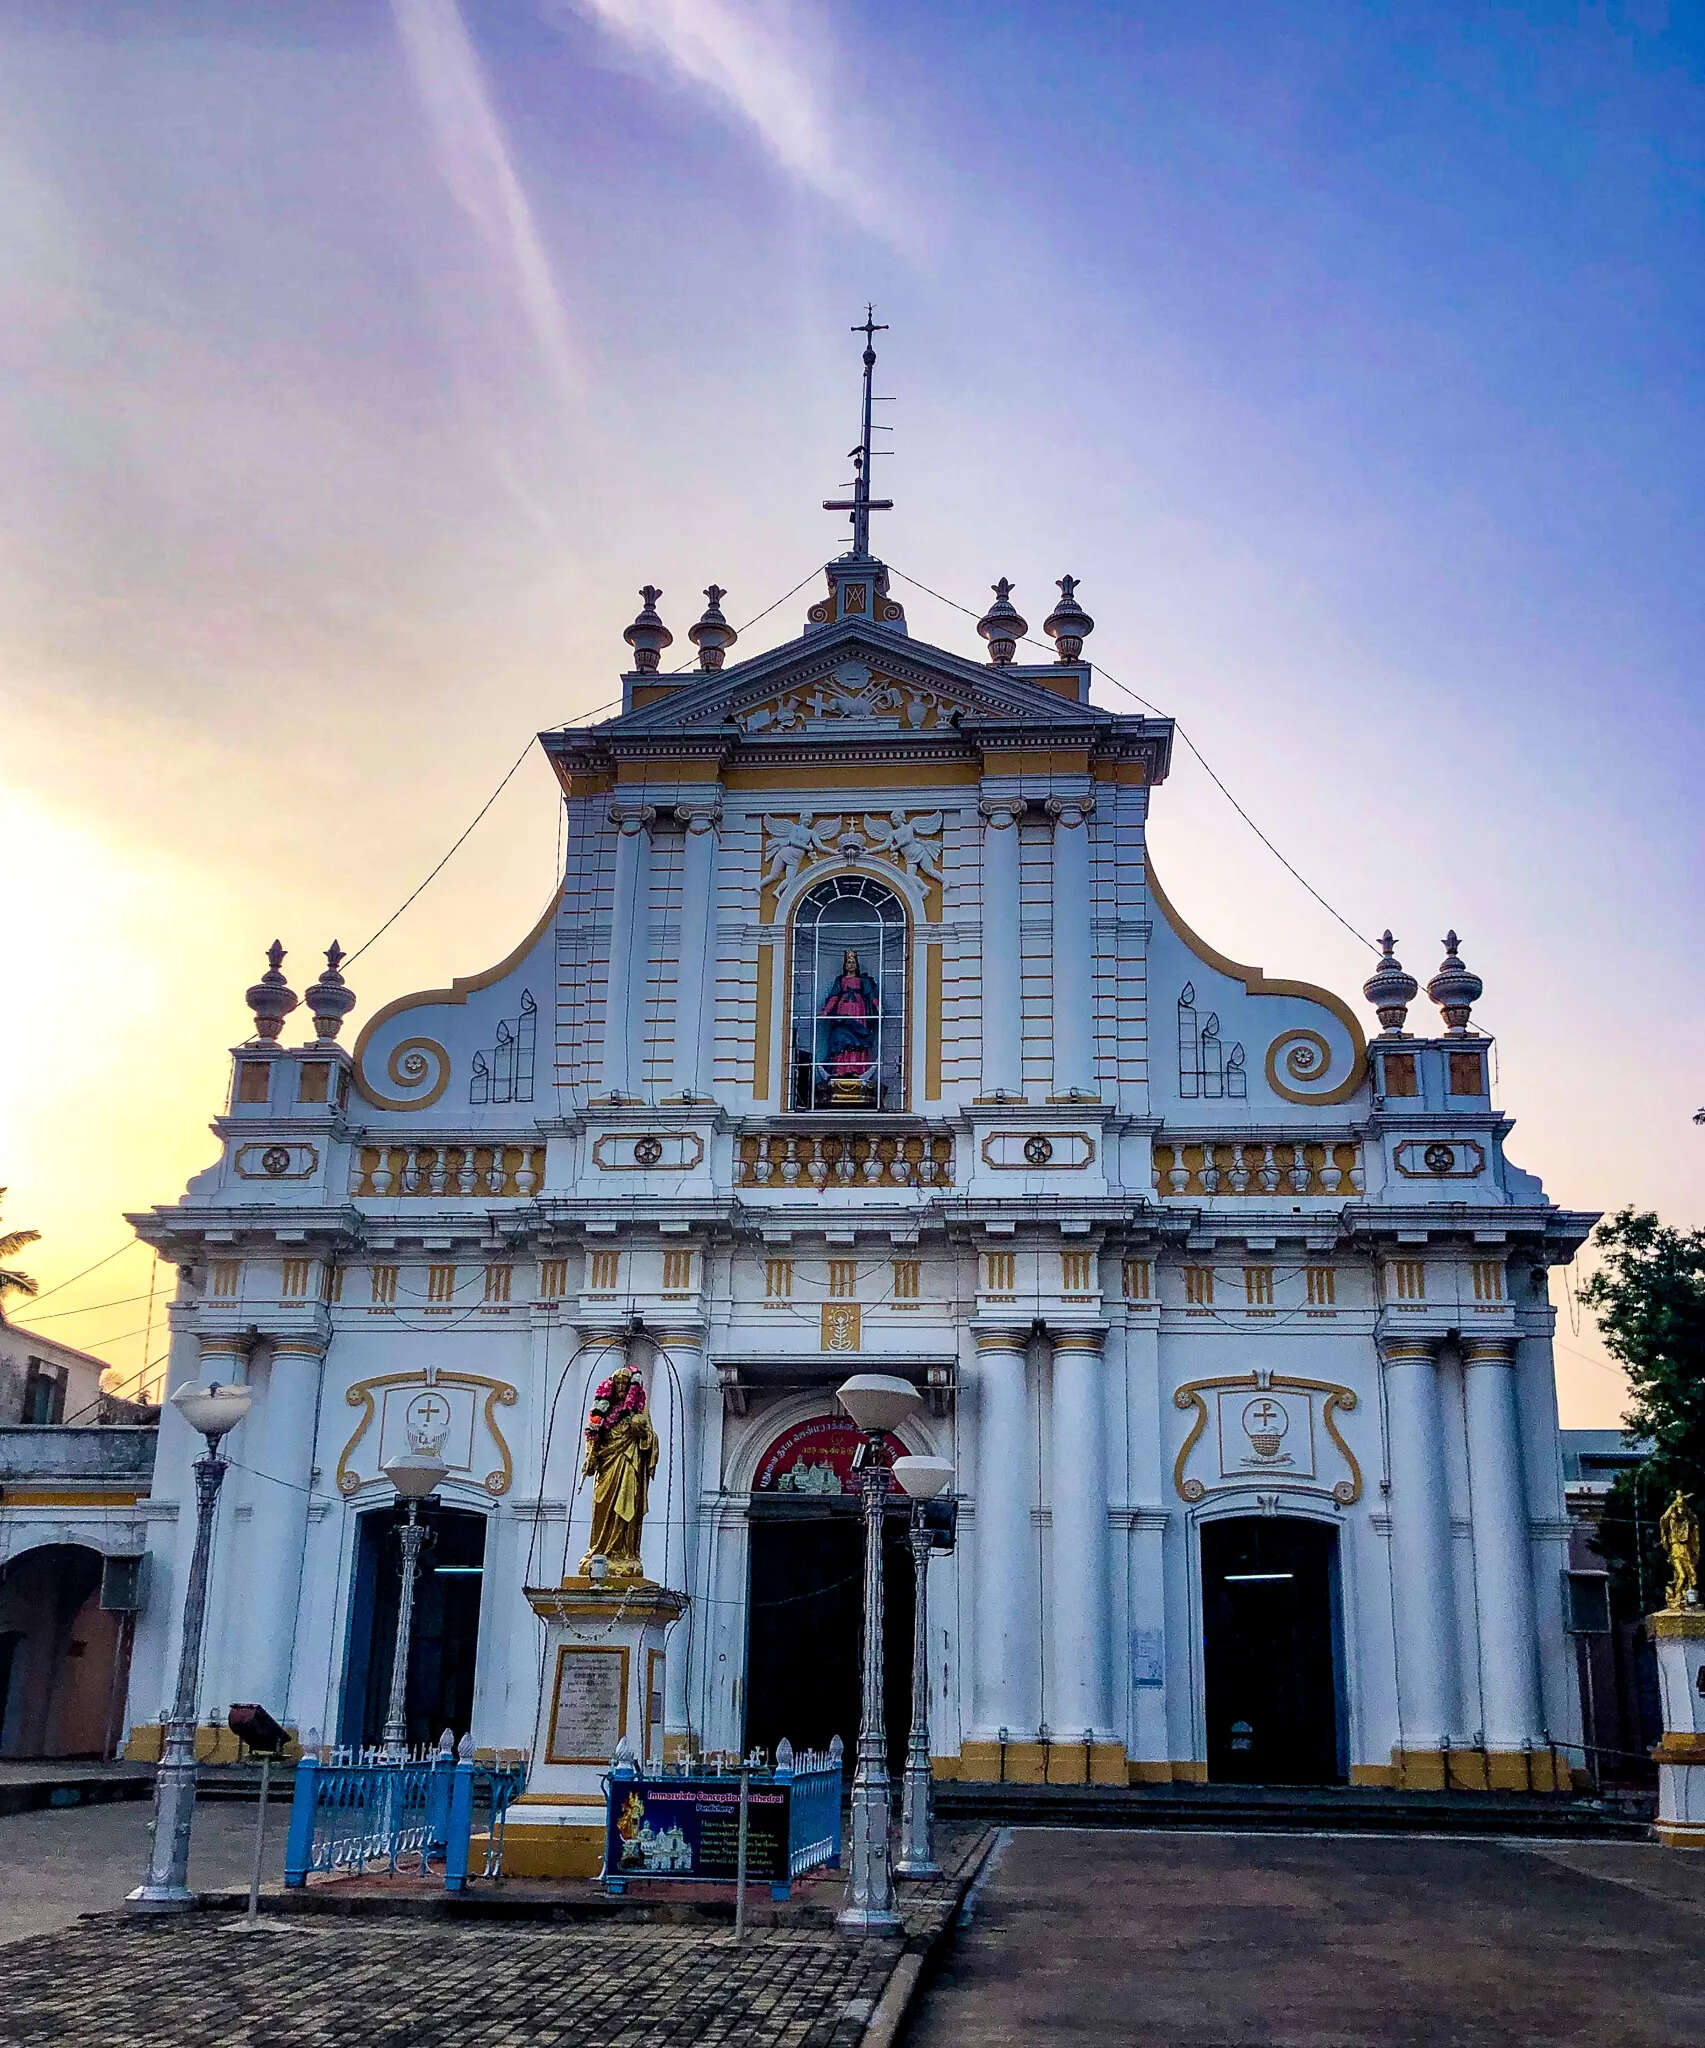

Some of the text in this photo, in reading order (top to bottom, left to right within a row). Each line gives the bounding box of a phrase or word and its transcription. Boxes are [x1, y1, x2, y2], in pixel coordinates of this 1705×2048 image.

[648, 1790, 784, 1803] Immaculate Conception athedral
